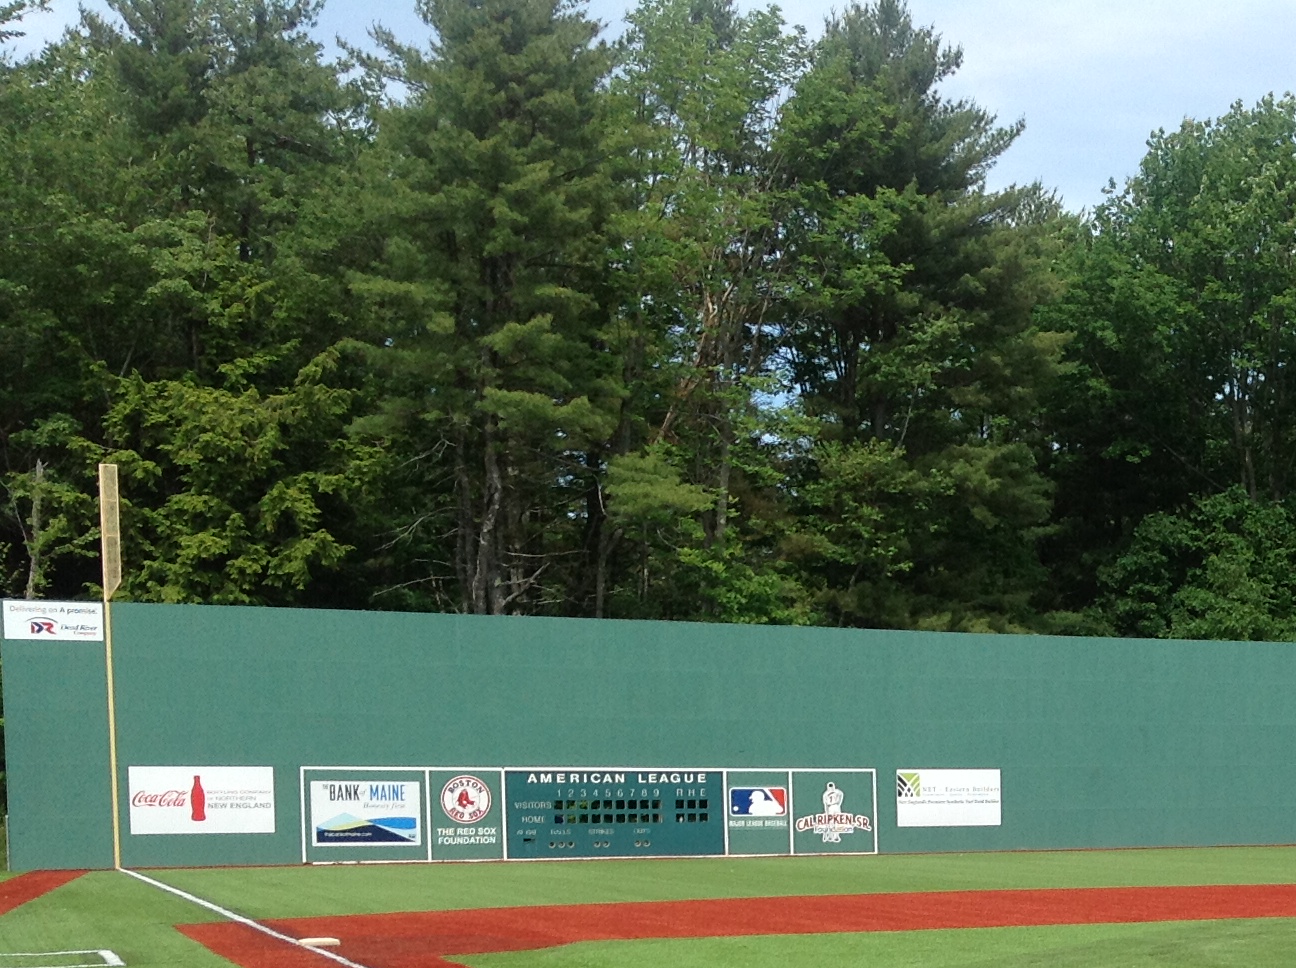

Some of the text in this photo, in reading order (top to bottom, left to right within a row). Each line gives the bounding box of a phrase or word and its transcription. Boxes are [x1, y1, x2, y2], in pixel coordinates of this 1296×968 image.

[527, 773, 707, 784] AMERICAN LEAGUE
[329, 783, 360, 801] BANK
[369, 783, 406, 801] MAINE
[447, 780, 486, 794] BOSTON
[557, 788, 707, 798] 1 2 3 4 5 6 7 8 9 R H E
[132, 790, 188, 808] Coca-Cola
[207, 802, 228, 810] NEW
[514, 801, 552, 810] VISITORS
[449, 807, 485, 820] RED SOX
[521, 815, 545, 824] HOME
[797, 817, 814, 831] CAL
[437, 827, 497, 836] THE RED SOX
[438, 836, 497, 845] FOUNDATION
